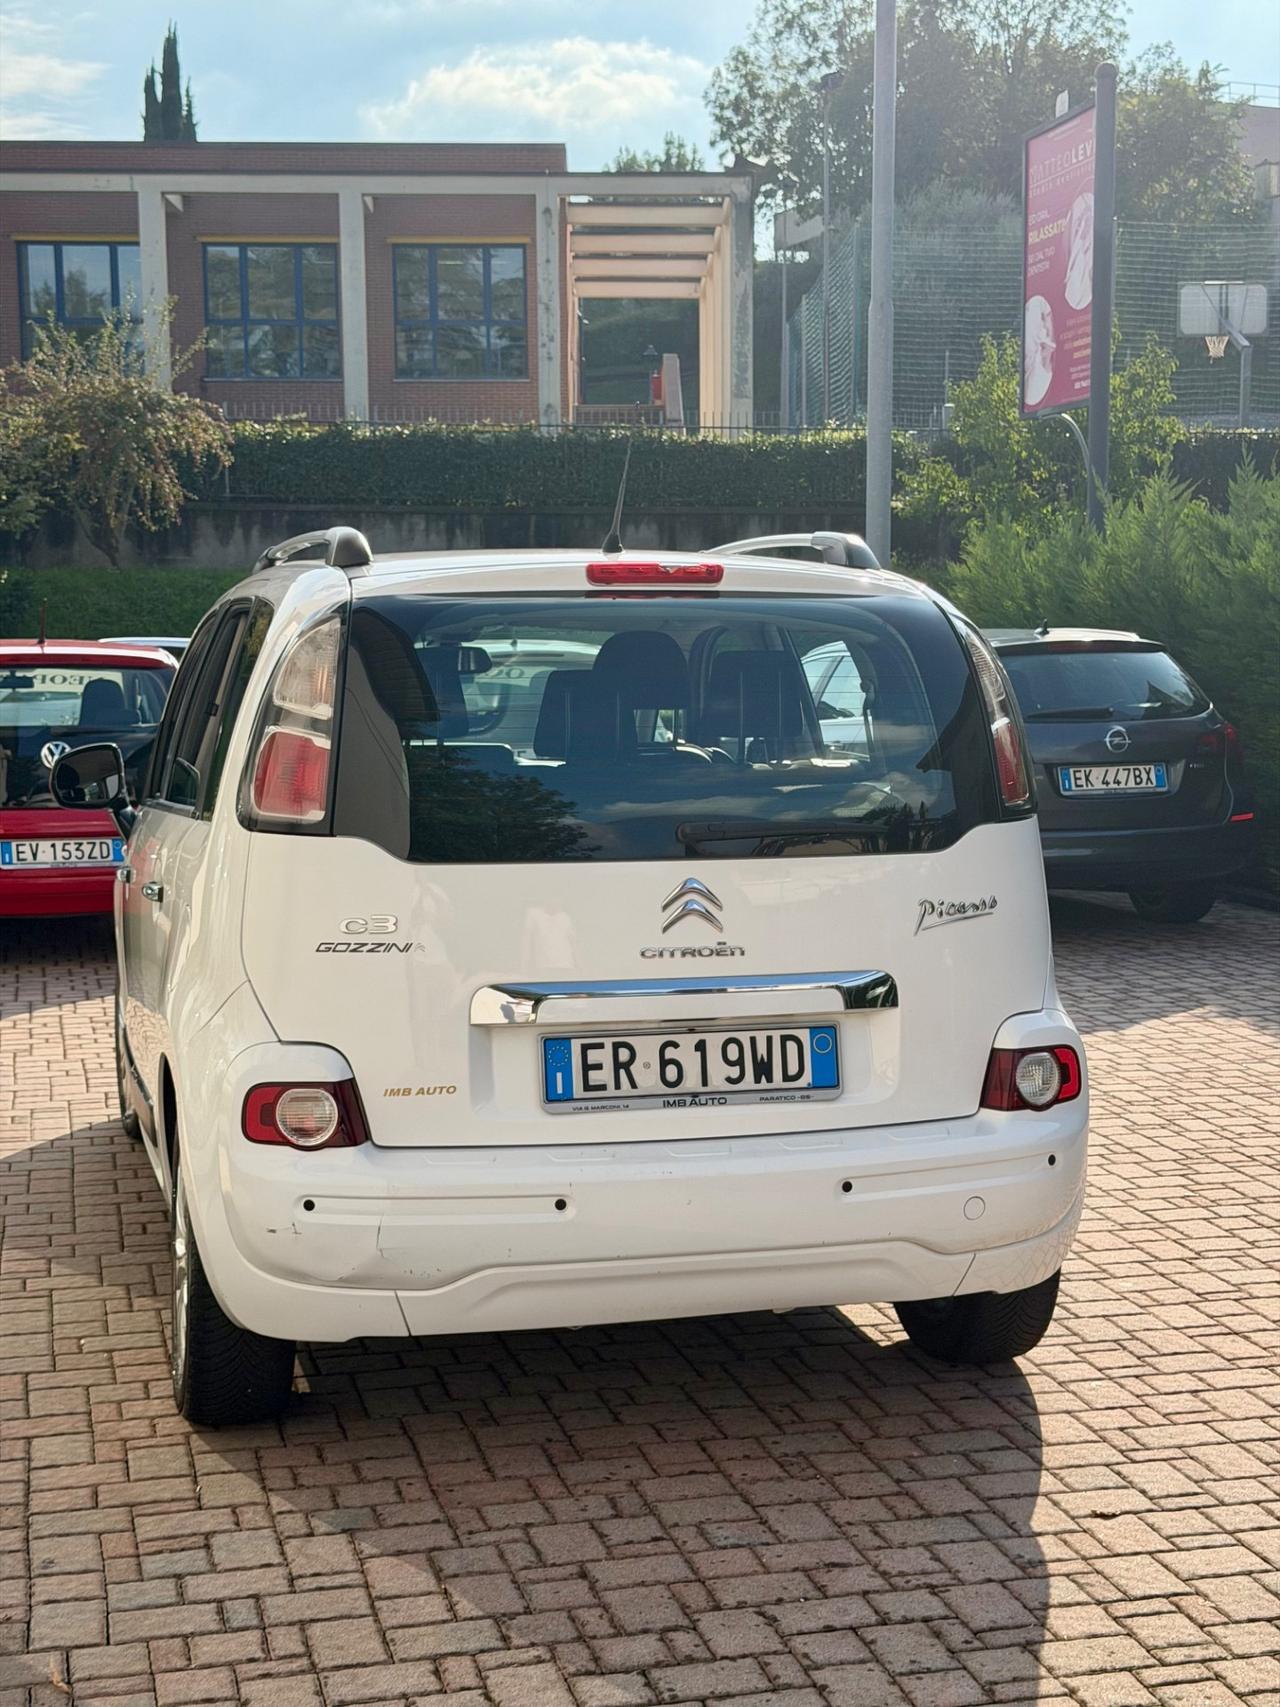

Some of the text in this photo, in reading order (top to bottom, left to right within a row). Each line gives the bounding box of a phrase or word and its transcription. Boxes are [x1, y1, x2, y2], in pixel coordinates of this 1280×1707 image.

[1073, 769, 1094, 788] EK
[1101, 766, 1154, 787] 447BX
[16, 843, 39, 862] EV
[50, 841, 110, 861] 153ZD
[339, 914, 399, 935] C3
[914, 895, 998, 936] Picasso
[315, 942, 414, 953] GOZZINI
[580, 1041, 638, 1092] ER
[658, 1034, 806, 1089] 619WD
[383, 1085, 457, 1097] IMB AUTO
[662, 1097, 728, 1108] IMB AUTO
